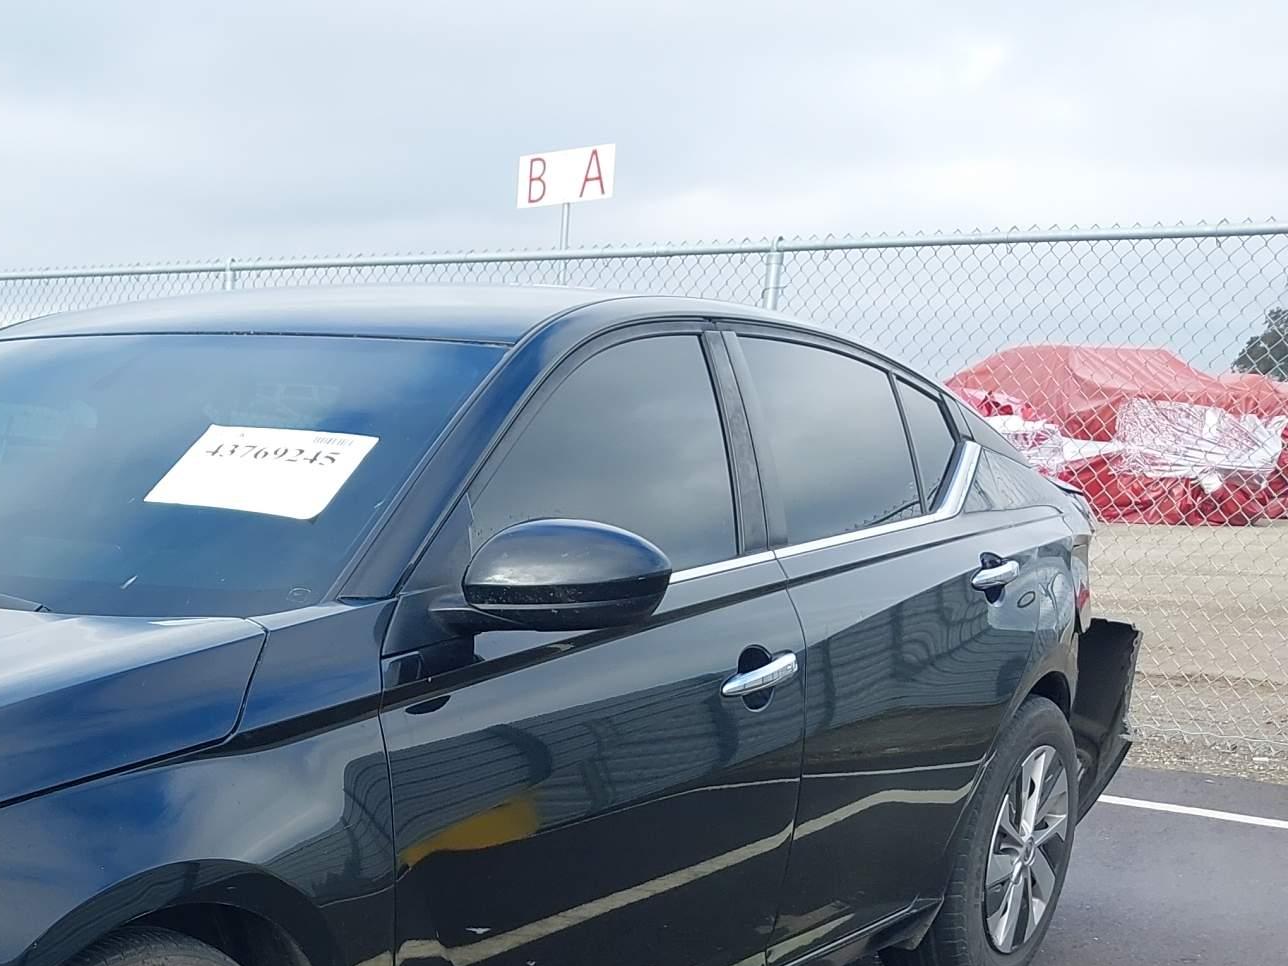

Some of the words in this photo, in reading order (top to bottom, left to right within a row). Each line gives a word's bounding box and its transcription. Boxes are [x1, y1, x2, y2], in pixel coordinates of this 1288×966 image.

[527, 157, 547, 204] B
[578, 148, 606, 199] A
[205, 443, 342, 466] 43769245
